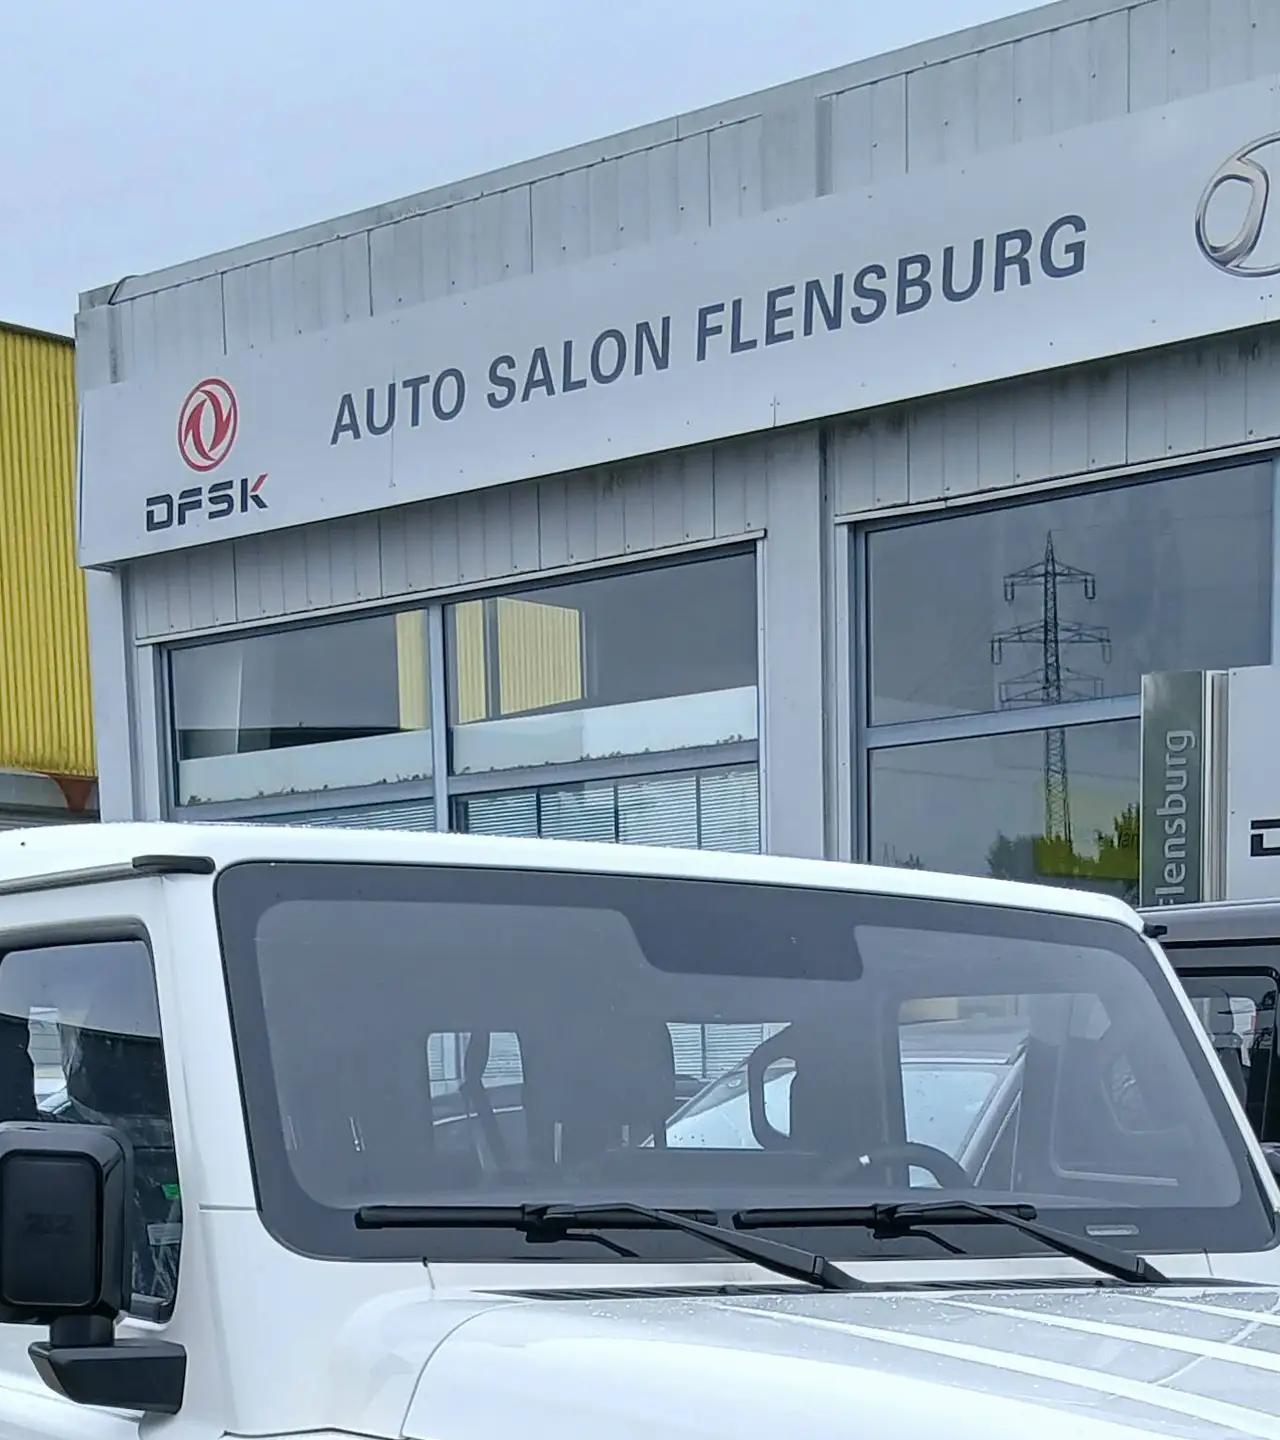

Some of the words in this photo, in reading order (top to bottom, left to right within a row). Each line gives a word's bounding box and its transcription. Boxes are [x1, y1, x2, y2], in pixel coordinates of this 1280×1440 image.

[330, 368, 466, 445] AUTO
[486, 315, 671, 410] SALON
[696, 214, 1087, 362] FLENSBURG
[146, 473, 268, 532] DFSK
